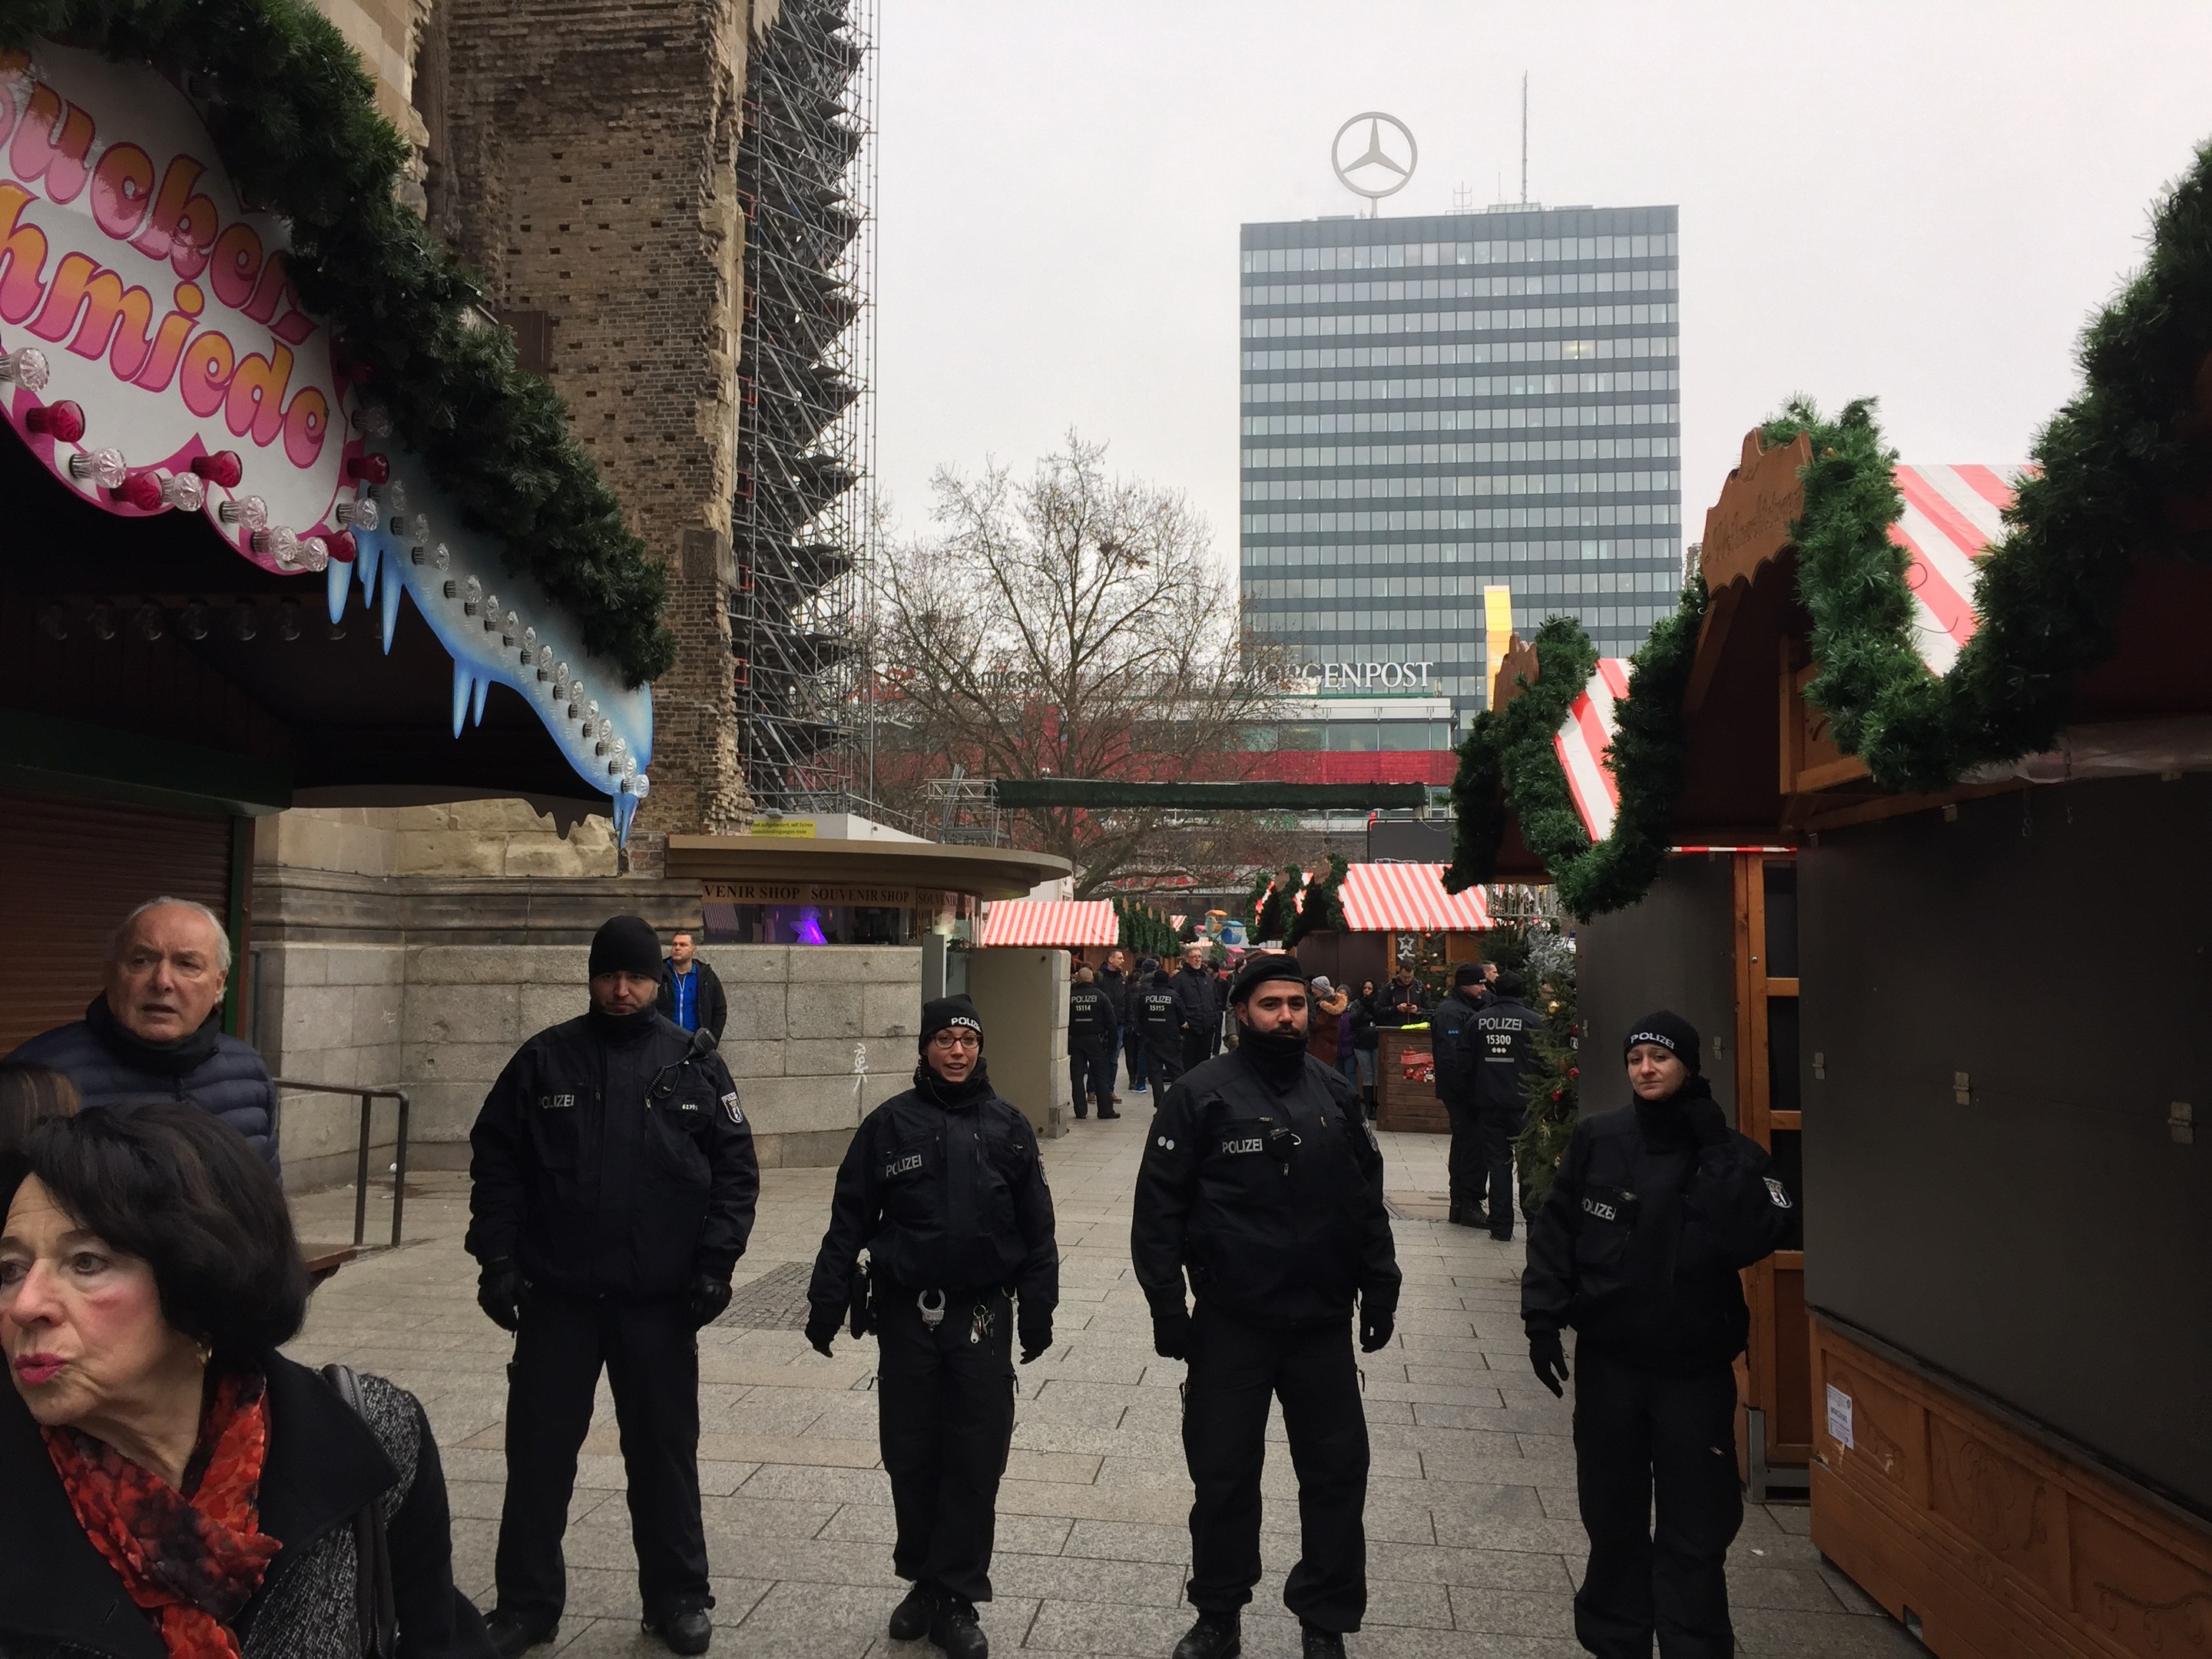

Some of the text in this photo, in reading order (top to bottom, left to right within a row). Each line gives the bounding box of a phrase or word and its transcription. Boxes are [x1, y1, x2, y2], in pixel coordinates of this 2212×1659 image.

[760, 886, 800, 899] SHOP
[811, 888, 909, 903] SOUVENIR SHOP
[1071, 995, 1098, 1004] POLIZEI
[1145, 995, 1172, 1005] POLIZEI
[1478, 1017, 1522, 1031] POLIZEI
[1485, 1034, 1512, 1045] 15300
[1630, 1031, 1675, 1050] POLIZEI
[538, 1094, 575, 1109] OLIZEI
[1222, 1138, 1263, 1154] POLIZEI
[886, 1154, 922, 1177] POLIZEI
